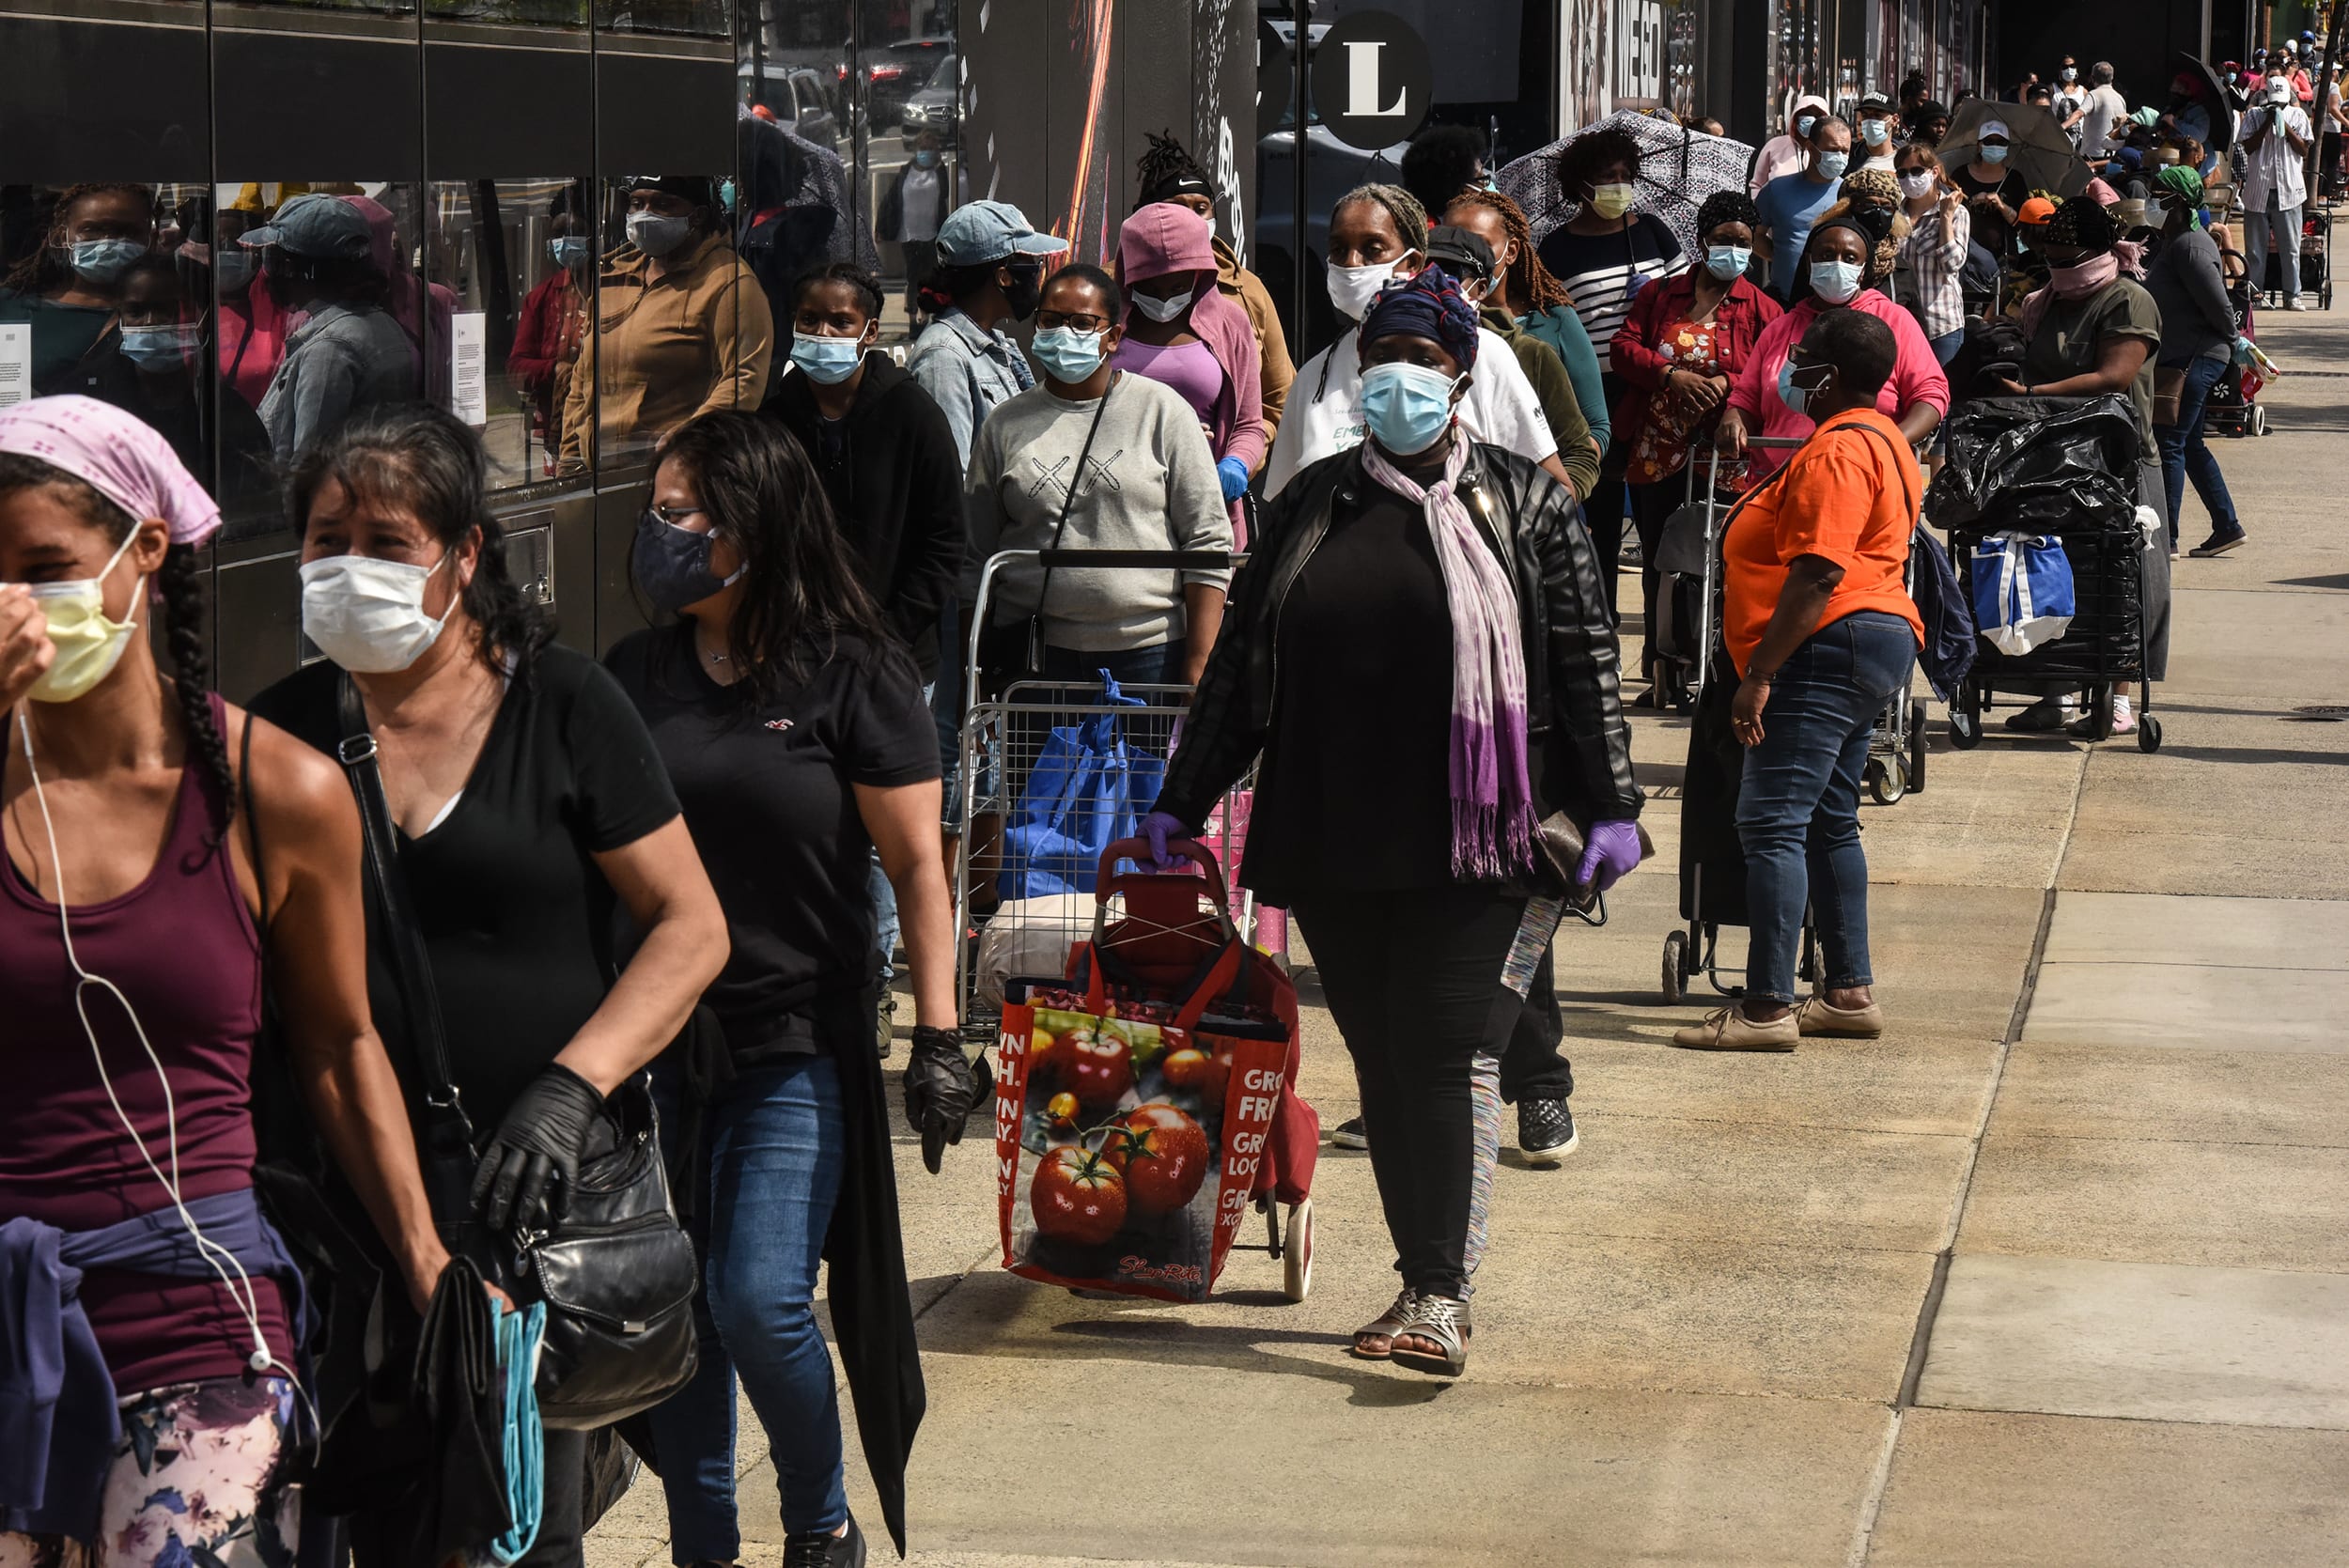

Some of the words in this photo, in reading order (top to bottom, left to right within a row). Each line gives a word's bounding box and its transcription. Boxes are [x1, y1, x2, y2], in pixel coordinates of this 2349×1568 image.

[1343, 42, 1407, 116] L
[1335, 441, 1361, 452] Y
[1233, 1131, 1264, 1155] GR
[1118, 1255, 1202, 1283] ShopRite
